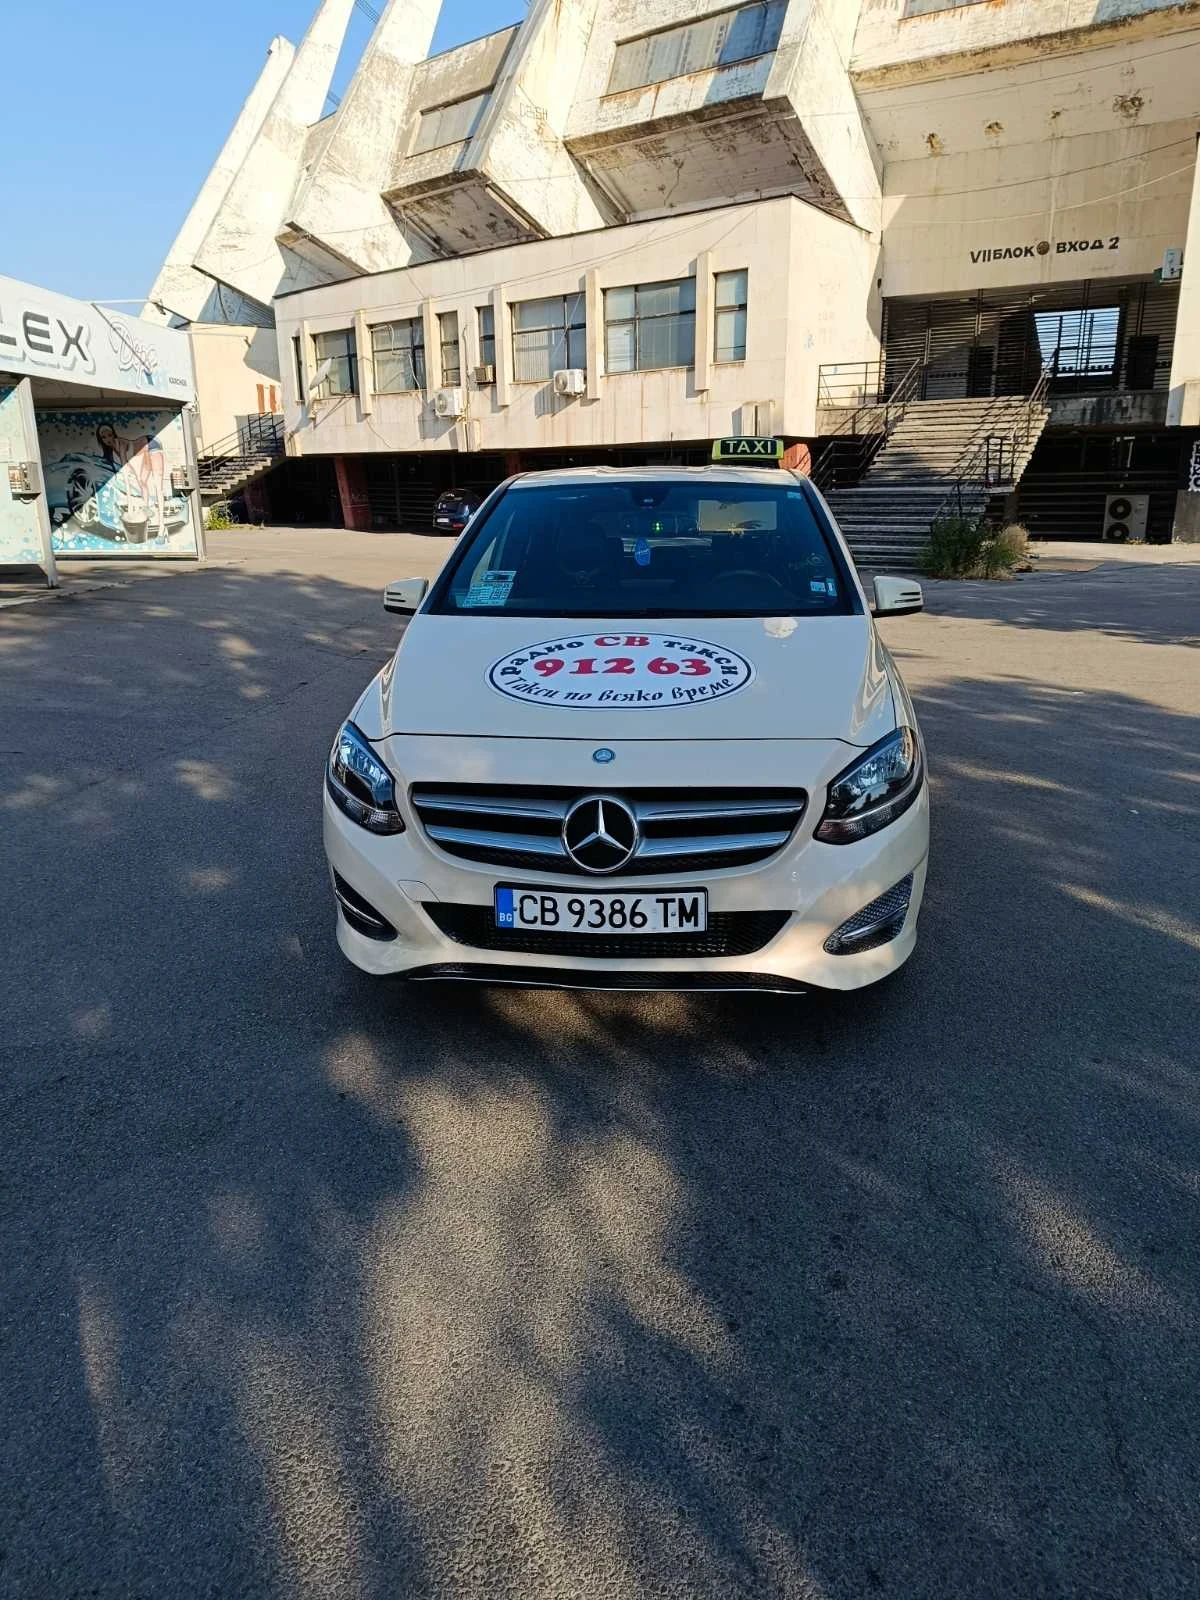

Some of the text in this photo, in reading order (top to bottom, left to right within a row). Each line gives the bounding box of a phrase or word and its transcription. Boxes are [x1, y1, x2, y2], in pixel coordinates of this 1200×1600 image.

[1055, 239, 1105, 254] ВХОД
[1108, 236, 1120, 250] 2
[725, 440, 772, 454] TAXI
[647, 656, 712, 676] 63
[663, 640, 739, 676] такси
[504, 677, 734, 702] Такси по всяко време
[499, 912, 513, 922] BG
[567, 898, 648, 929] 9386
